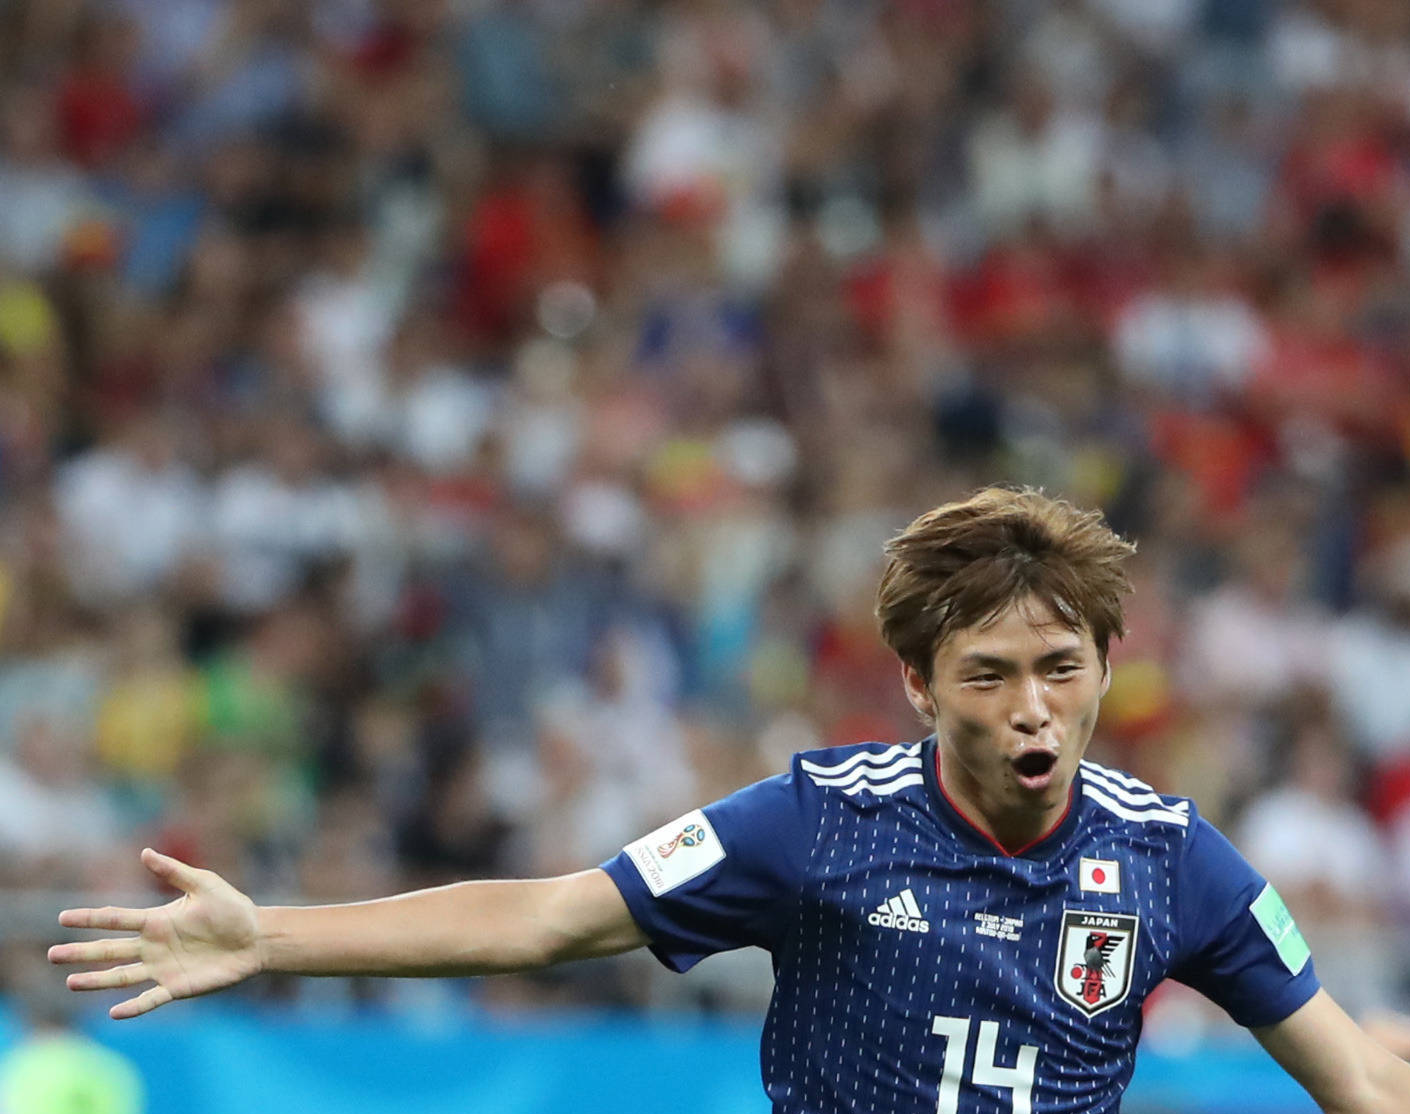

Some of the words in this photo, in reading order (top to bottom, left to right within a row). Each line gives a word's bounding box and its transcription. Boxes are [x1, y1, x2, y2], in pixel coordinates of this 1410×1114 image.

[867, 912, 930, 933] adidas
[1081, 916, 1119, 928] JAPAN
[1076, 981, 1107, 998] JFA
